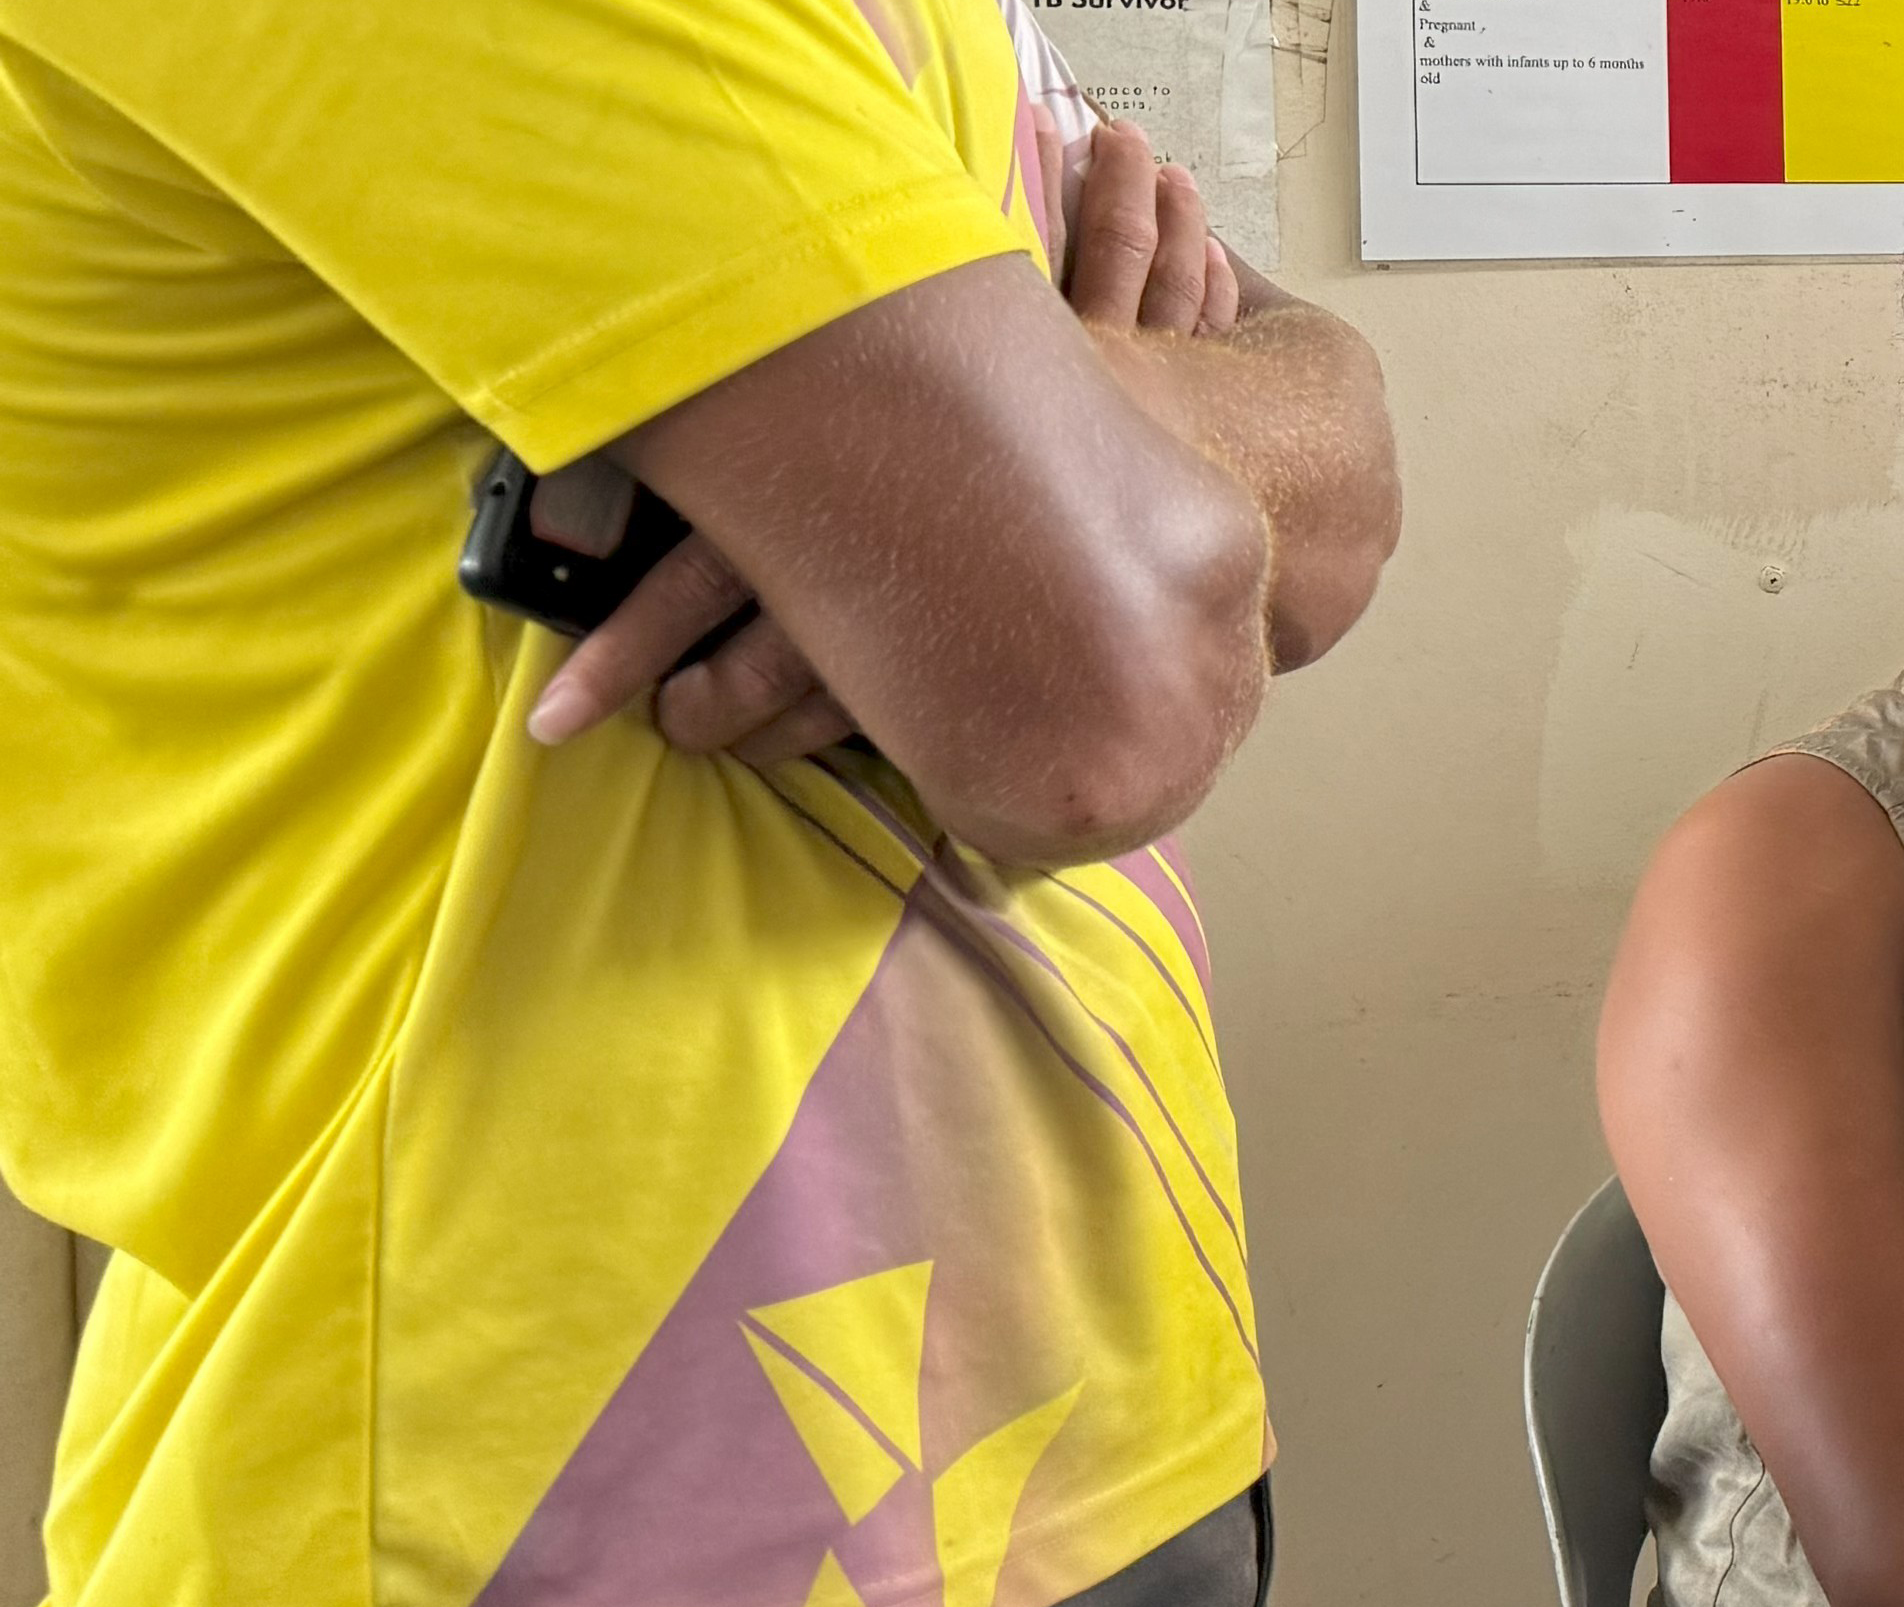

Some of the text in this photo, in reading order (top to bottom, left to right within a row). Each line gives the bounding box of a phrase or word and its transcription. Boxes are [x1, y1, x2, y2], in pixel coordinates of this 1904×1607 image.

[1419, 17, 1476, 34] Pregnant
[1419, 54, 1645, 71] mothers with infants up to 6 months
[1420, 71, 1441, 85] old
